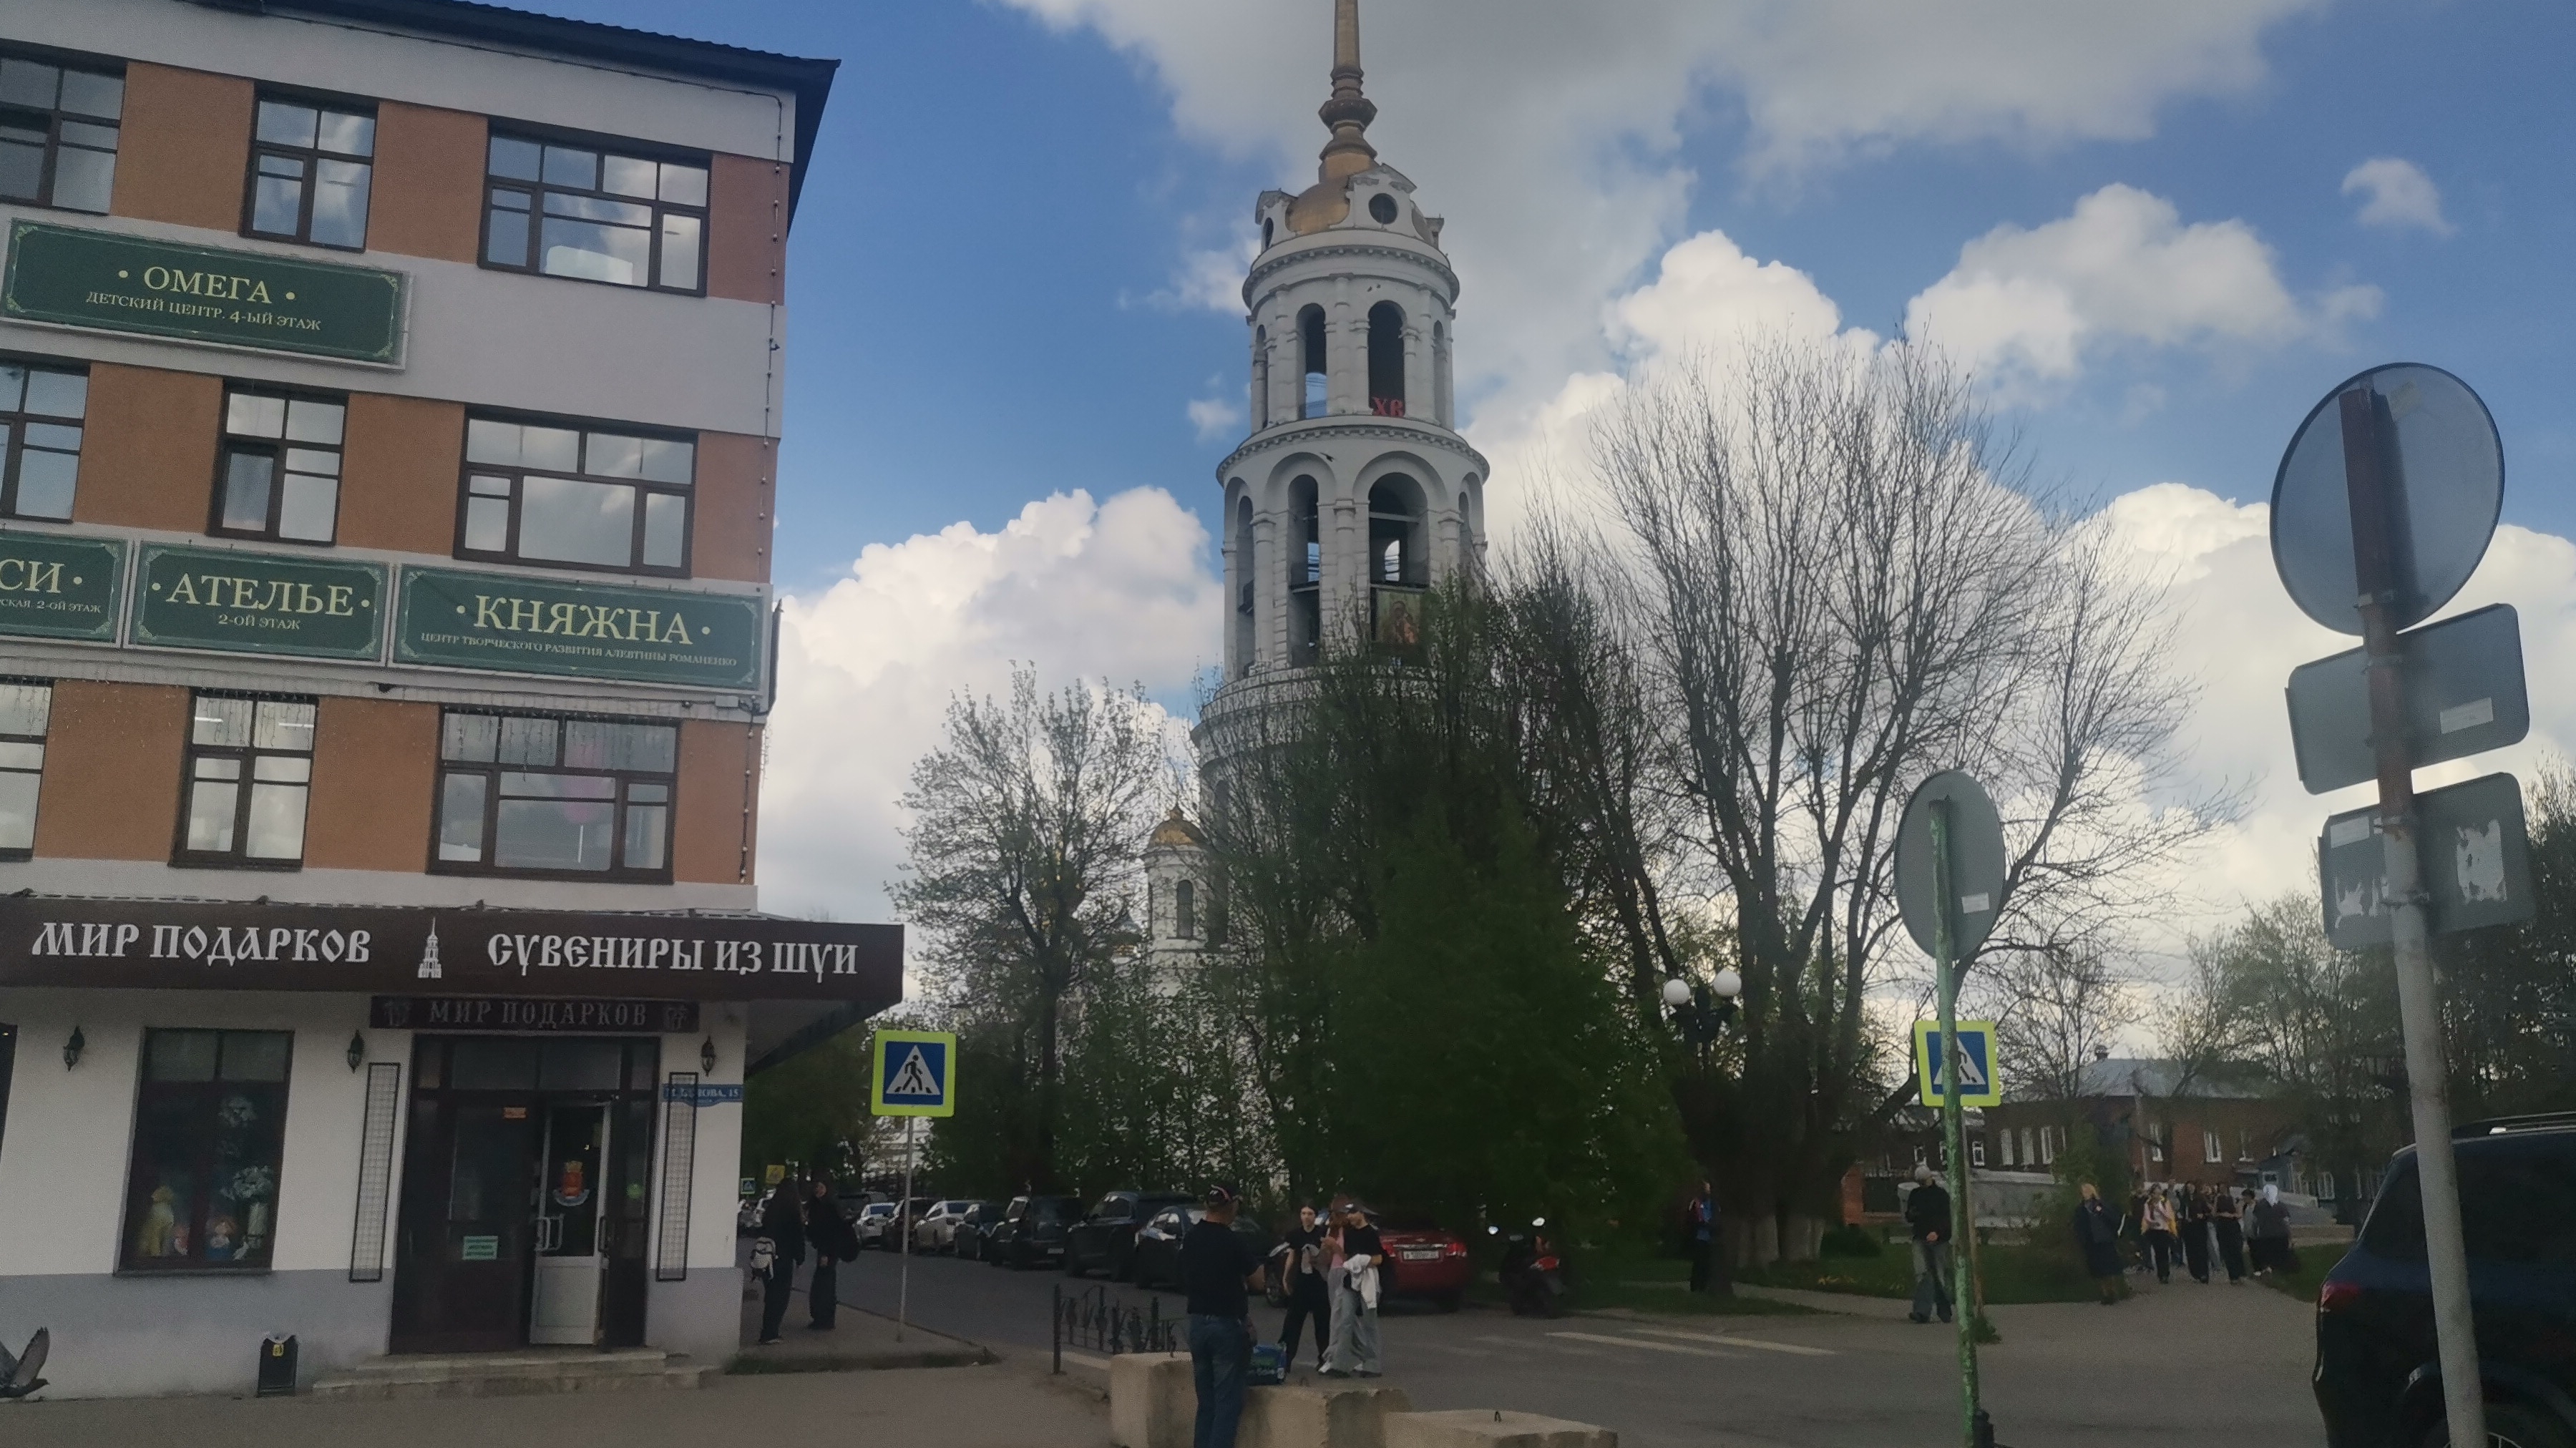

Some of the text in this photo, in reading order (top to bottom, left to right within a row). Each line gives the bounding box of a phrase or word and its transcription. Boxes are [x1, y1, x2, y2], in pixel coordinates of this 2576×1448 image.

[144, 265, 272, 305] ОМЕГА
[85, 291, 321, 331] ДЕТСКИЙ ЦЕНТР. 4-ЫЙ ЭТАЖ
[36, 600, 67, 611] 2-ОЙ
[69, 602, 101, 614] ЭТАЖ
[165, 572, 354, 616] АТЕЛЬЕ
[218, 614, 301, 630] 2-ОЙ ЭТАЖ
[473, 595, 694, 645] КНЯЖНА
[421, 632, 737, 666] ЦЕНТР ТВОРЧЕСКОГО РАЗВИТИЯ АЛЕВТИНЫ РОМАНЕНКО
[31, 922, 371, 967] МИР ПОДАРКОВ
[488, 933, 859, 983] СУВЕНИРЫ ИЗ ШУИ
[429, 1000, 646, 1029] МИР ПОДАРКОВ
